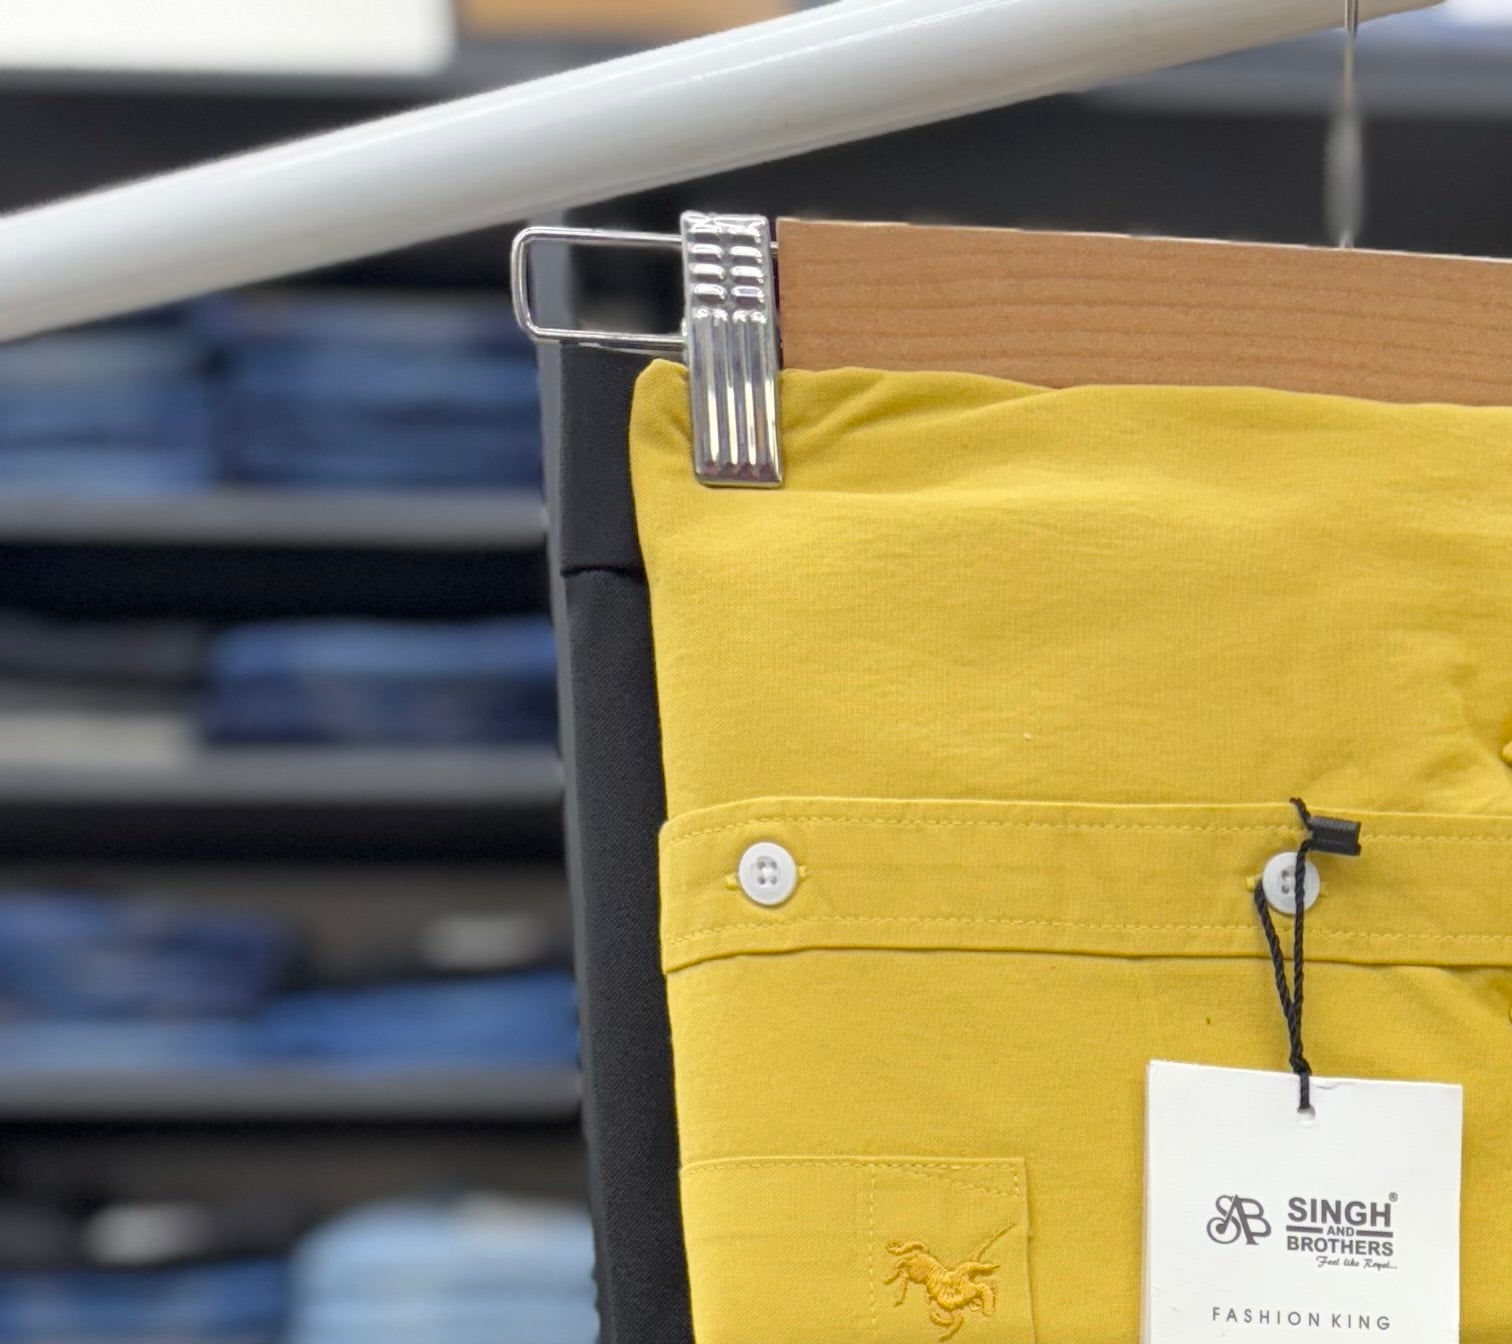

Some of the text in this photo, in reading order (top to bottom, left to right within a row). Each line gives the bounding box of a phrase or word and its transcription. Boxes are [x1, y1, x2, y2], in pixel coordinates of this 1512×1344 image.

[1287, 1196, 1391, 1228] SINGH
[1326, 1225, 1355, 1237] AND
[1286, 1235, 1394, 1257] BROTHERS
[1212, 1306, 1391, 1331] FASHION KING
